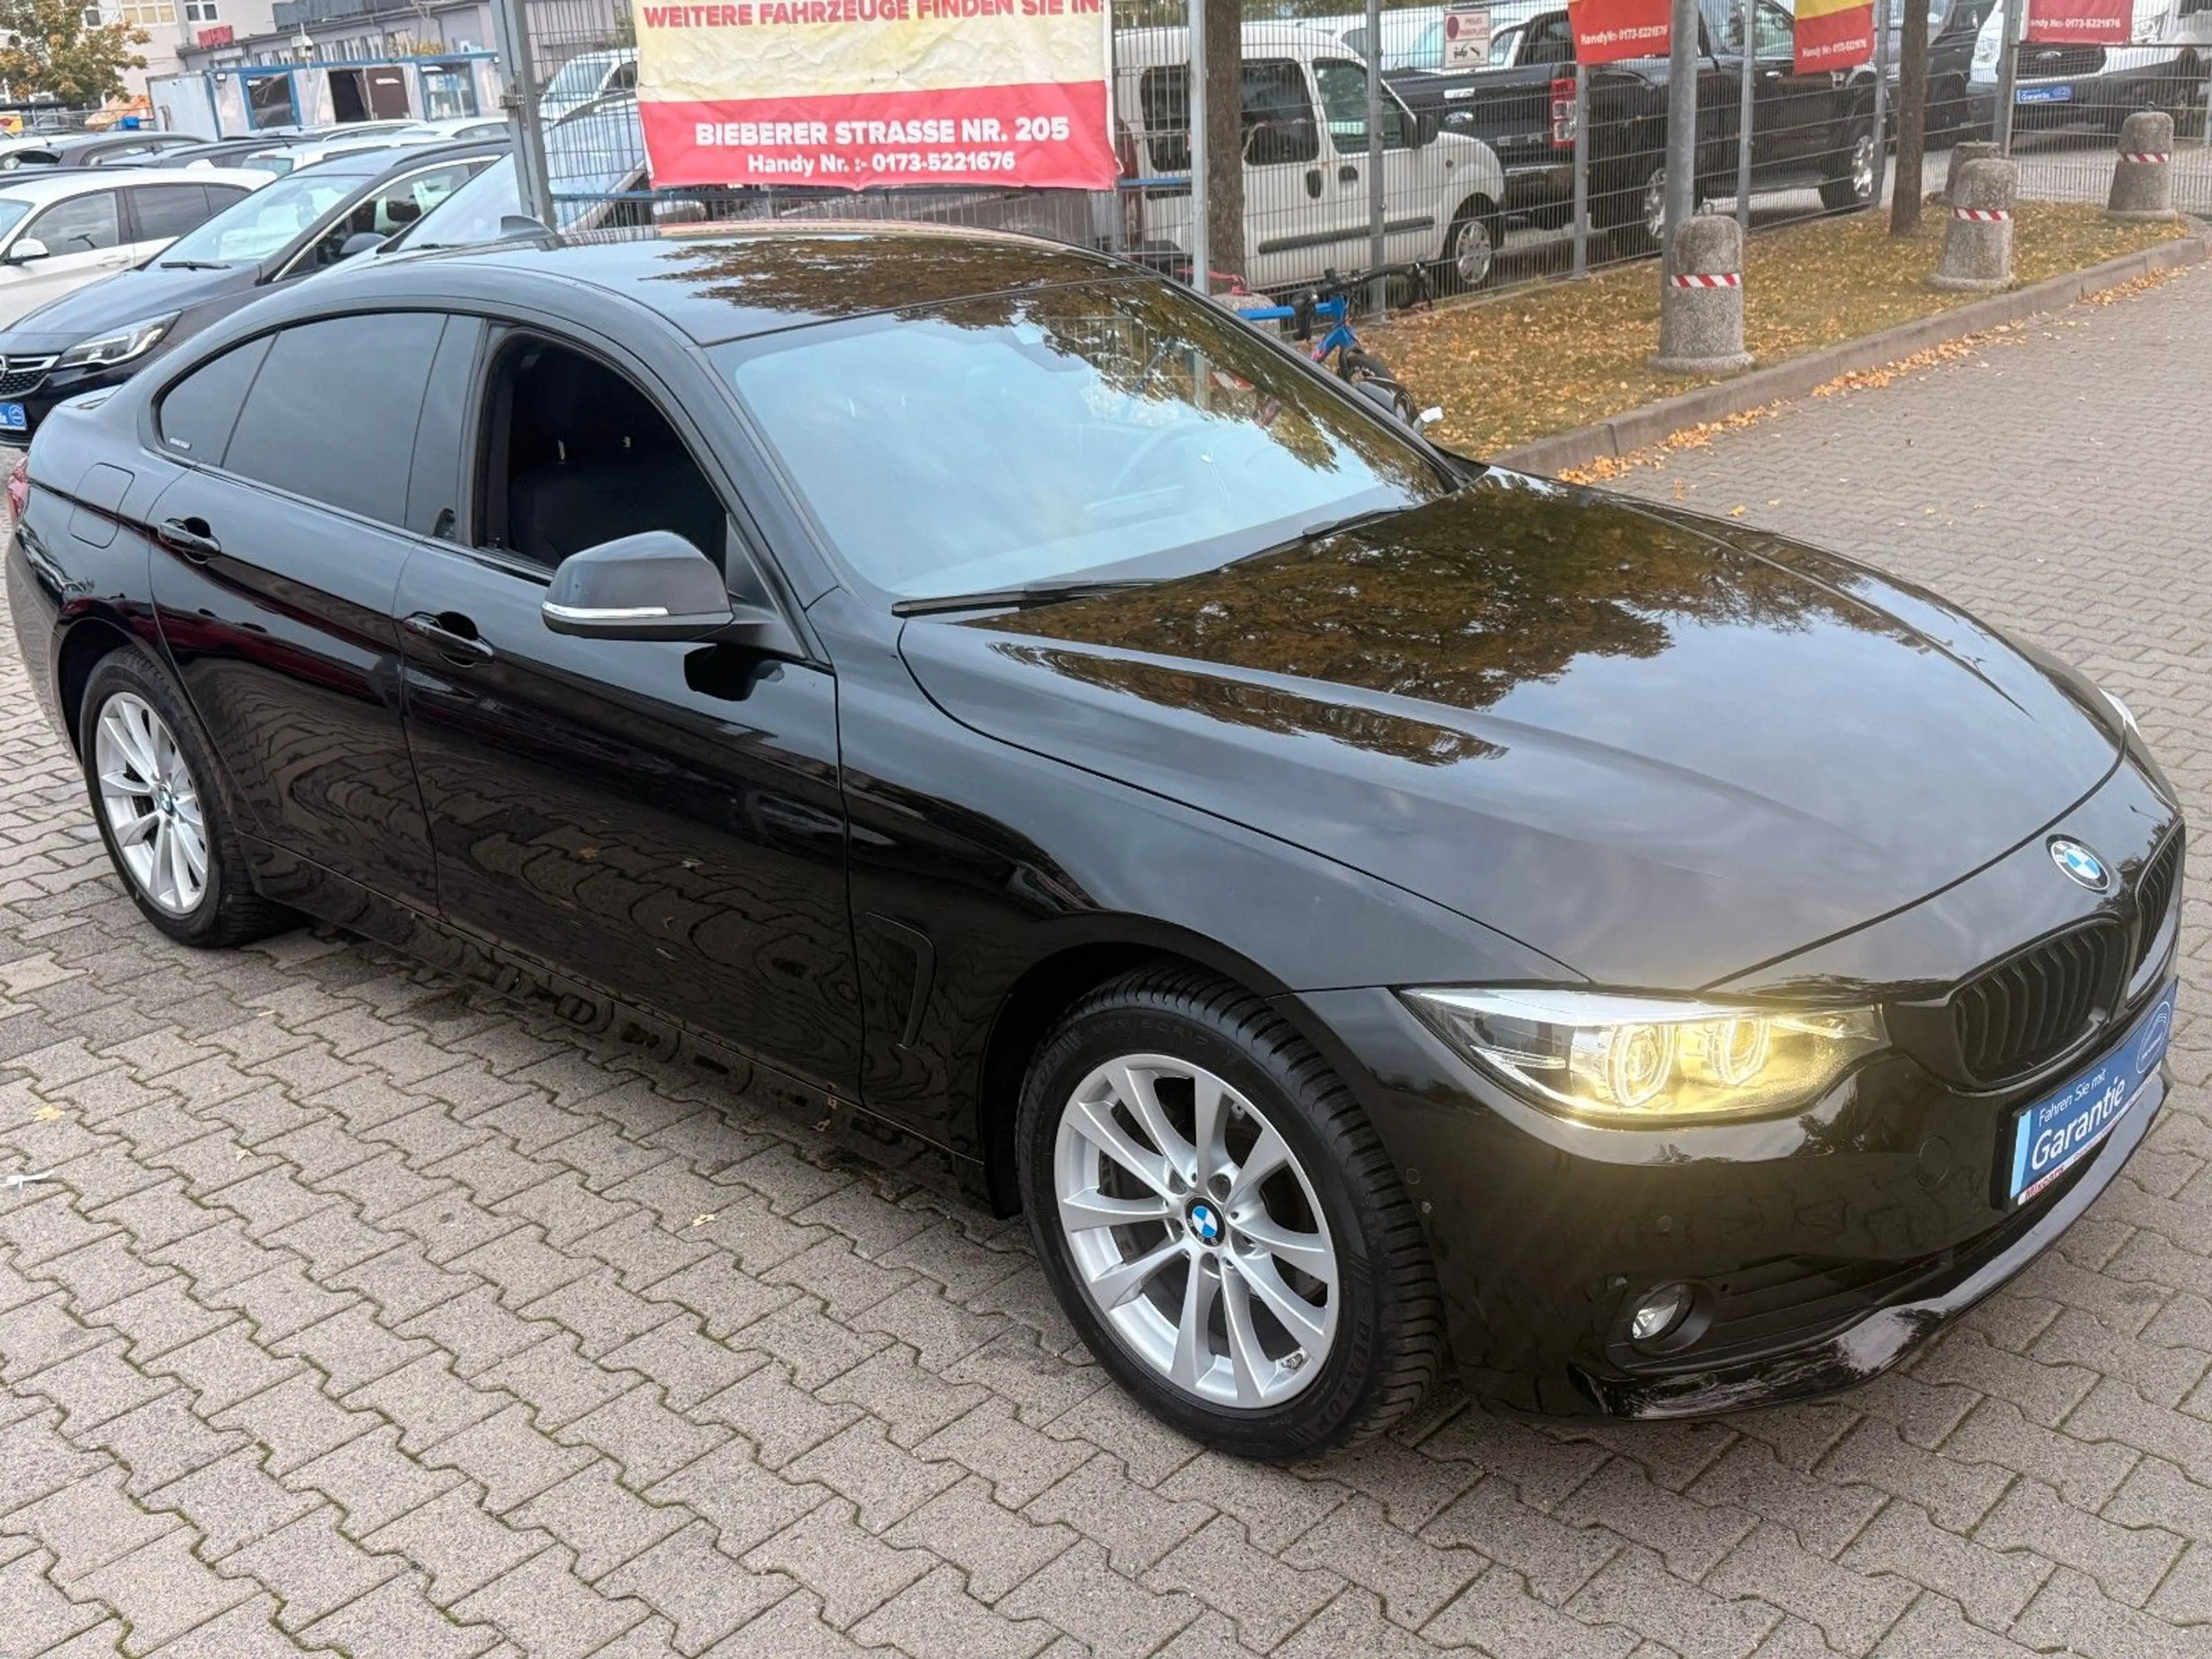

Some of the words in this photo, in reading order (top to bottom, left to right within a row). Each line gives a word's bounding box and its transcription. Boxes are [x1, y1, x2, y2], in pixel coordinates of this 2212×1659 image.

[643, 4, 752, 28] WEITERE
[760, 0, 910, 24] FAHRZEUGE
[917, 0, 1014, 19] FINDEN
[1022, 0, 1063, 16] SIE
[695, 122, 828, 146] BIEBERER
[835, 119, 956, 145] STRASSE
[961, 118, 1007, 143] NR.
[1014, 116, 1069, 142] 205
[748, 154, 815, 177] Handy
[820, 153, 849, 173] Nr.
[872, 151, 1015, 173] 0173-5221676
[2039, 1097, 2073, 1127] Fahren
[2074, 1081, 2090, 1099] Sie
[2091, 1067, 2107, 1089] mit
[2031, 1075, 2126, 1171] Garantie
